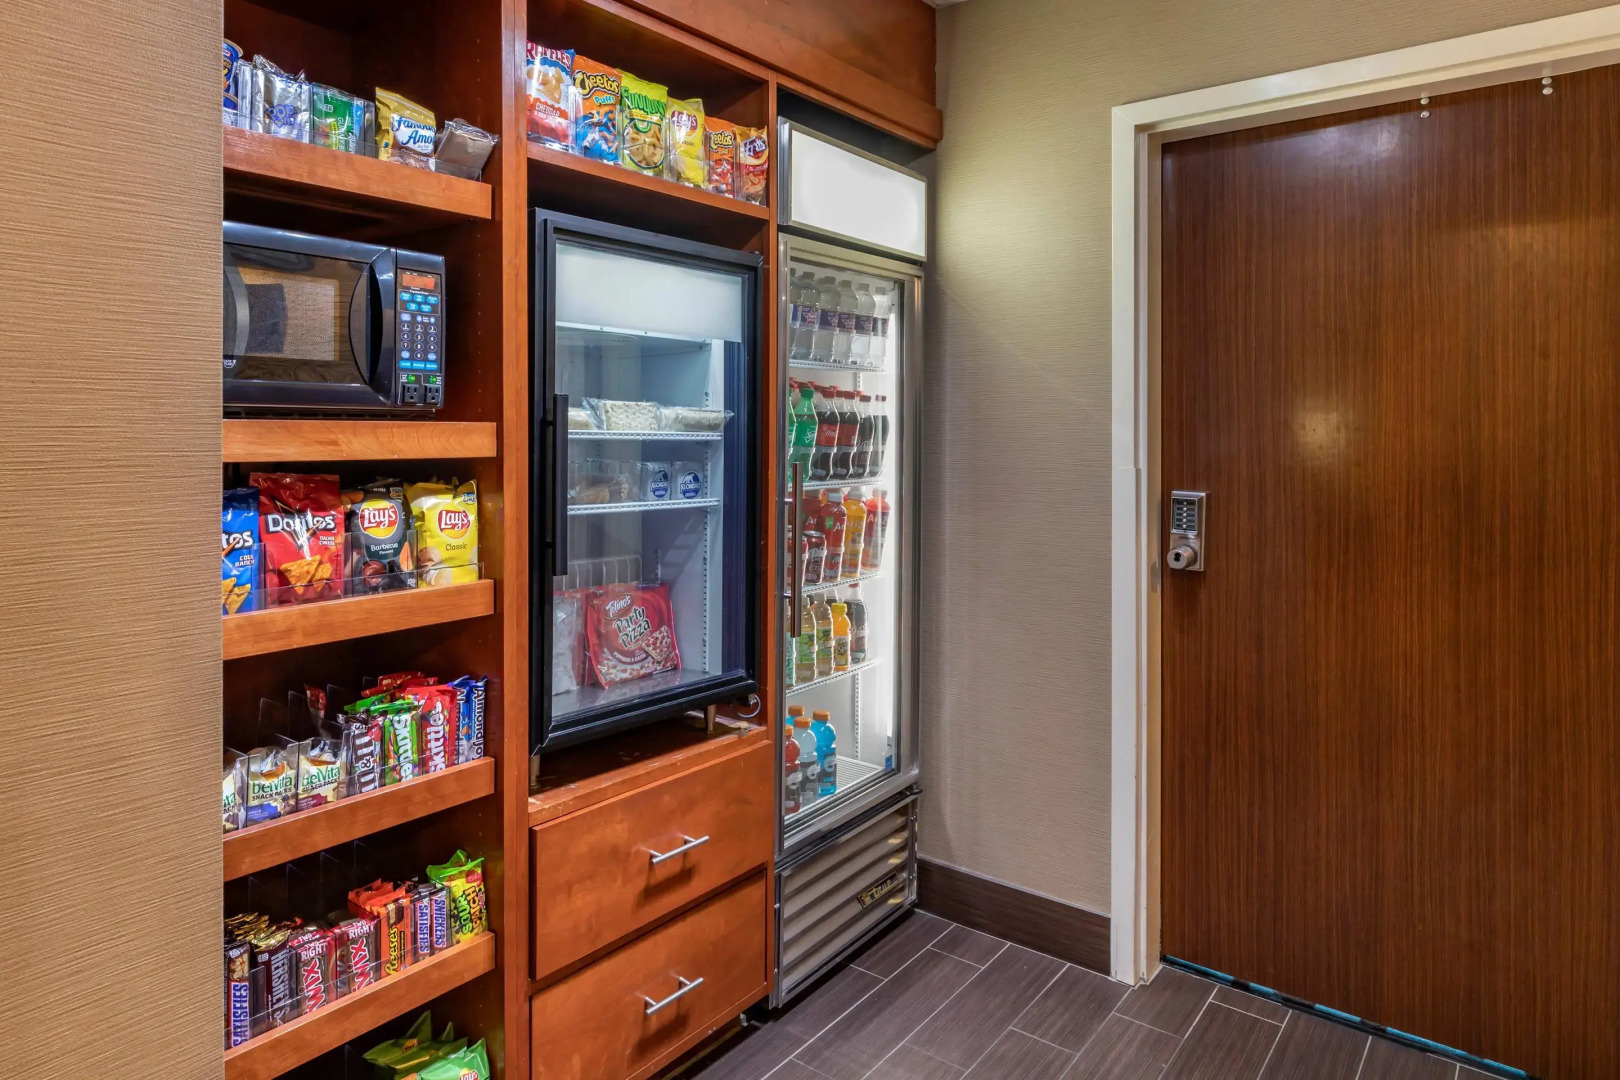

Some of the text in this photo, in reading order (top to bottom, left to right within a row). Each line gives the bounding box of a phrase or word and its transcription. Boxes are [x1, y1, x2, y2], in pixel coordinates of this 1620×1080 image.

[526, 41, 571, 69] RUFFLES
[574, 72, 619, 95] Cheetos
[391, 116, 436, 132] Famous
[710, 132, 732, 150] Ceetos
[267, 509, 336, 532] Doritos
[363, 505, 396, 528] Lay's
[441, 510, 468, 531] Lay's
[370, 542, 398, 551] Barbecue
[445, 542, 467, 551] Classic
[606, 595, 631, 617] Totino's
[615, 607, 645, 633] Party
[620, 620, 650, 647] Pizza
[473, 688, 485, 740] Almond
[252, 776, 292, 795] belVita
[302, 766, 340, 787] belVita
[251, 792, 274, 801] SNACK
[456, 894, 472, 935] SOUR
[465, 886, 480, 928] PATCH
[349, 922, 374, 939] RIGHT
[419, 905, 430, 952] SATISFIES
[434, 899, 446, 947] SNICKERS
[385, 927, 399, 976] Reese's
